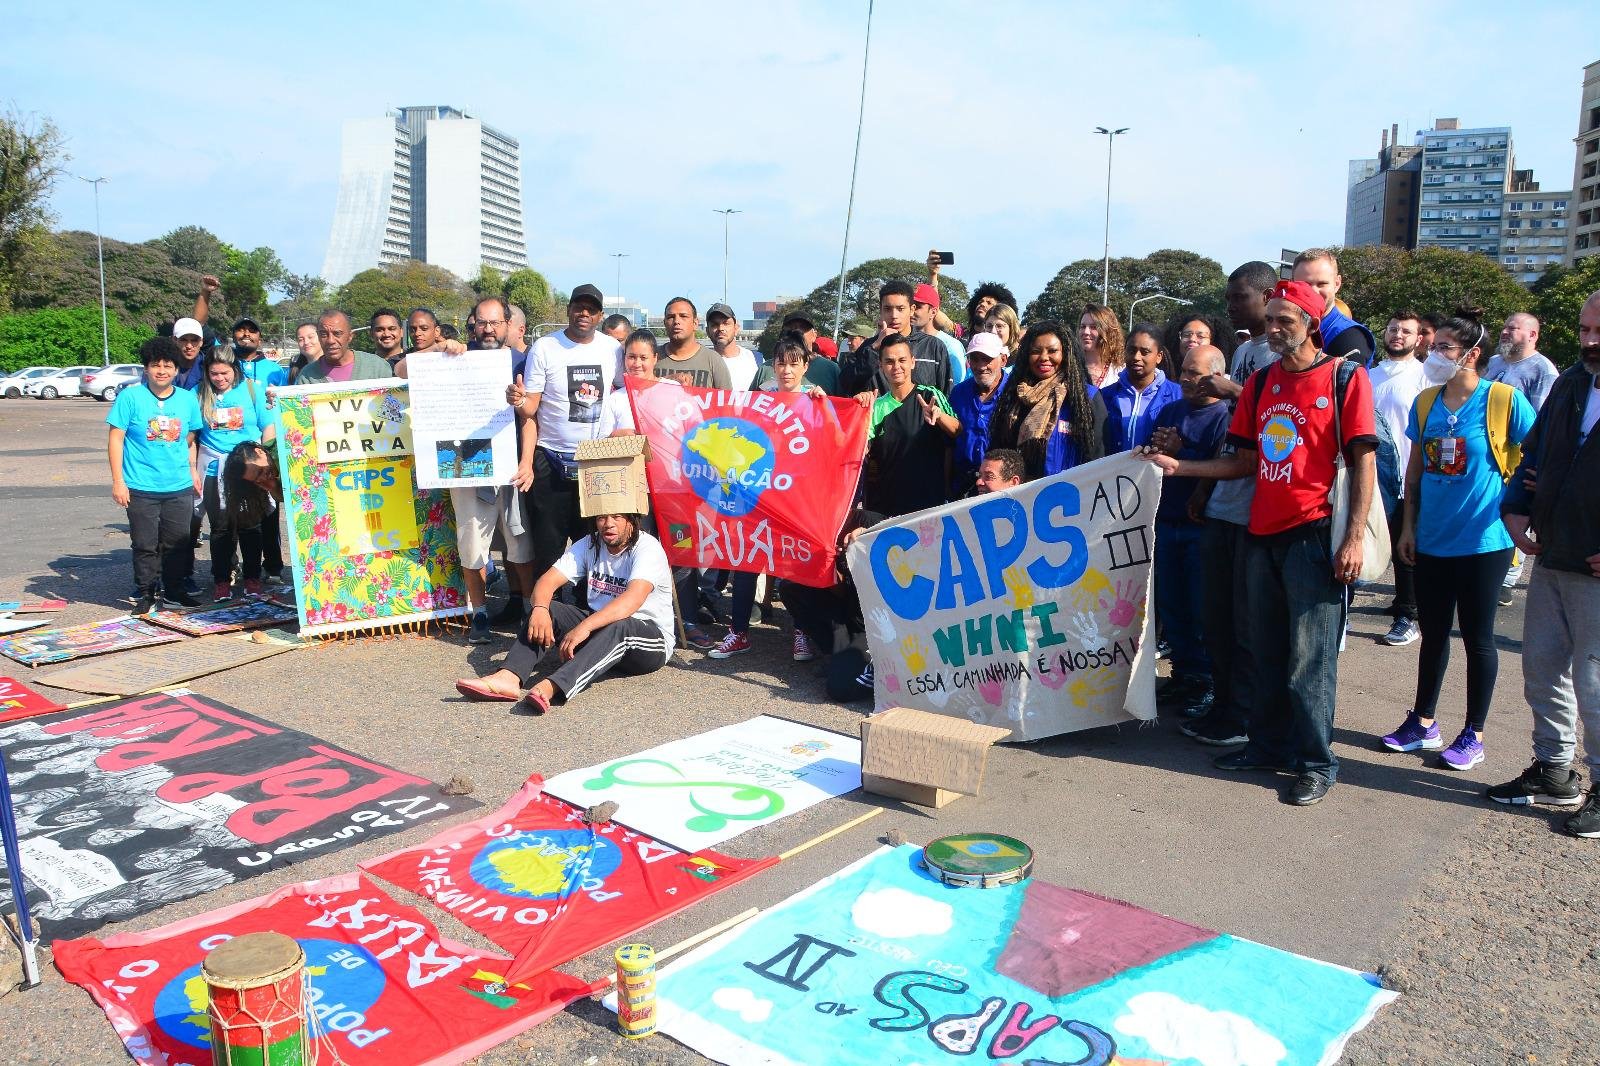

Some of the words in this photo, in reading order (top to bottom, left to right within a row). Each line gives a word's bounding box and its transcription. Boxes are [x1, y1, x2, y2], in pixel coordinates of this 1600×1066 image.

[663, 389, 810, 455] MOVIMENTO
[1260, 402, 1307, 425] MOVIMENTO
[326, 438, 352, 454] DA
[335, 467, 395, 491] CAPS
[1260, 458, 1293, 484] RUA
[696, 511, 775, 573] RUA
[780, 535, 812, 563] RS
[869, 481, 1089, 621] CAPS
[1089, 474, 1141, 523] AD
[1103, 525, 1152, 571] III
[906, 673, 946, 696] ESSA
[953, 660, 1031, 691] CAMINHADA
[1038, 653, 1052, 675] É
[236, 825, 366, 867] CAPS
[350, 809, 405, 828] AD
[378, 795, 450, 820] IV
[326, 948, 368, 970] DE
[814, 1001, 859, 1017] AD
[867, 969, 1117, 1066] CAPS
